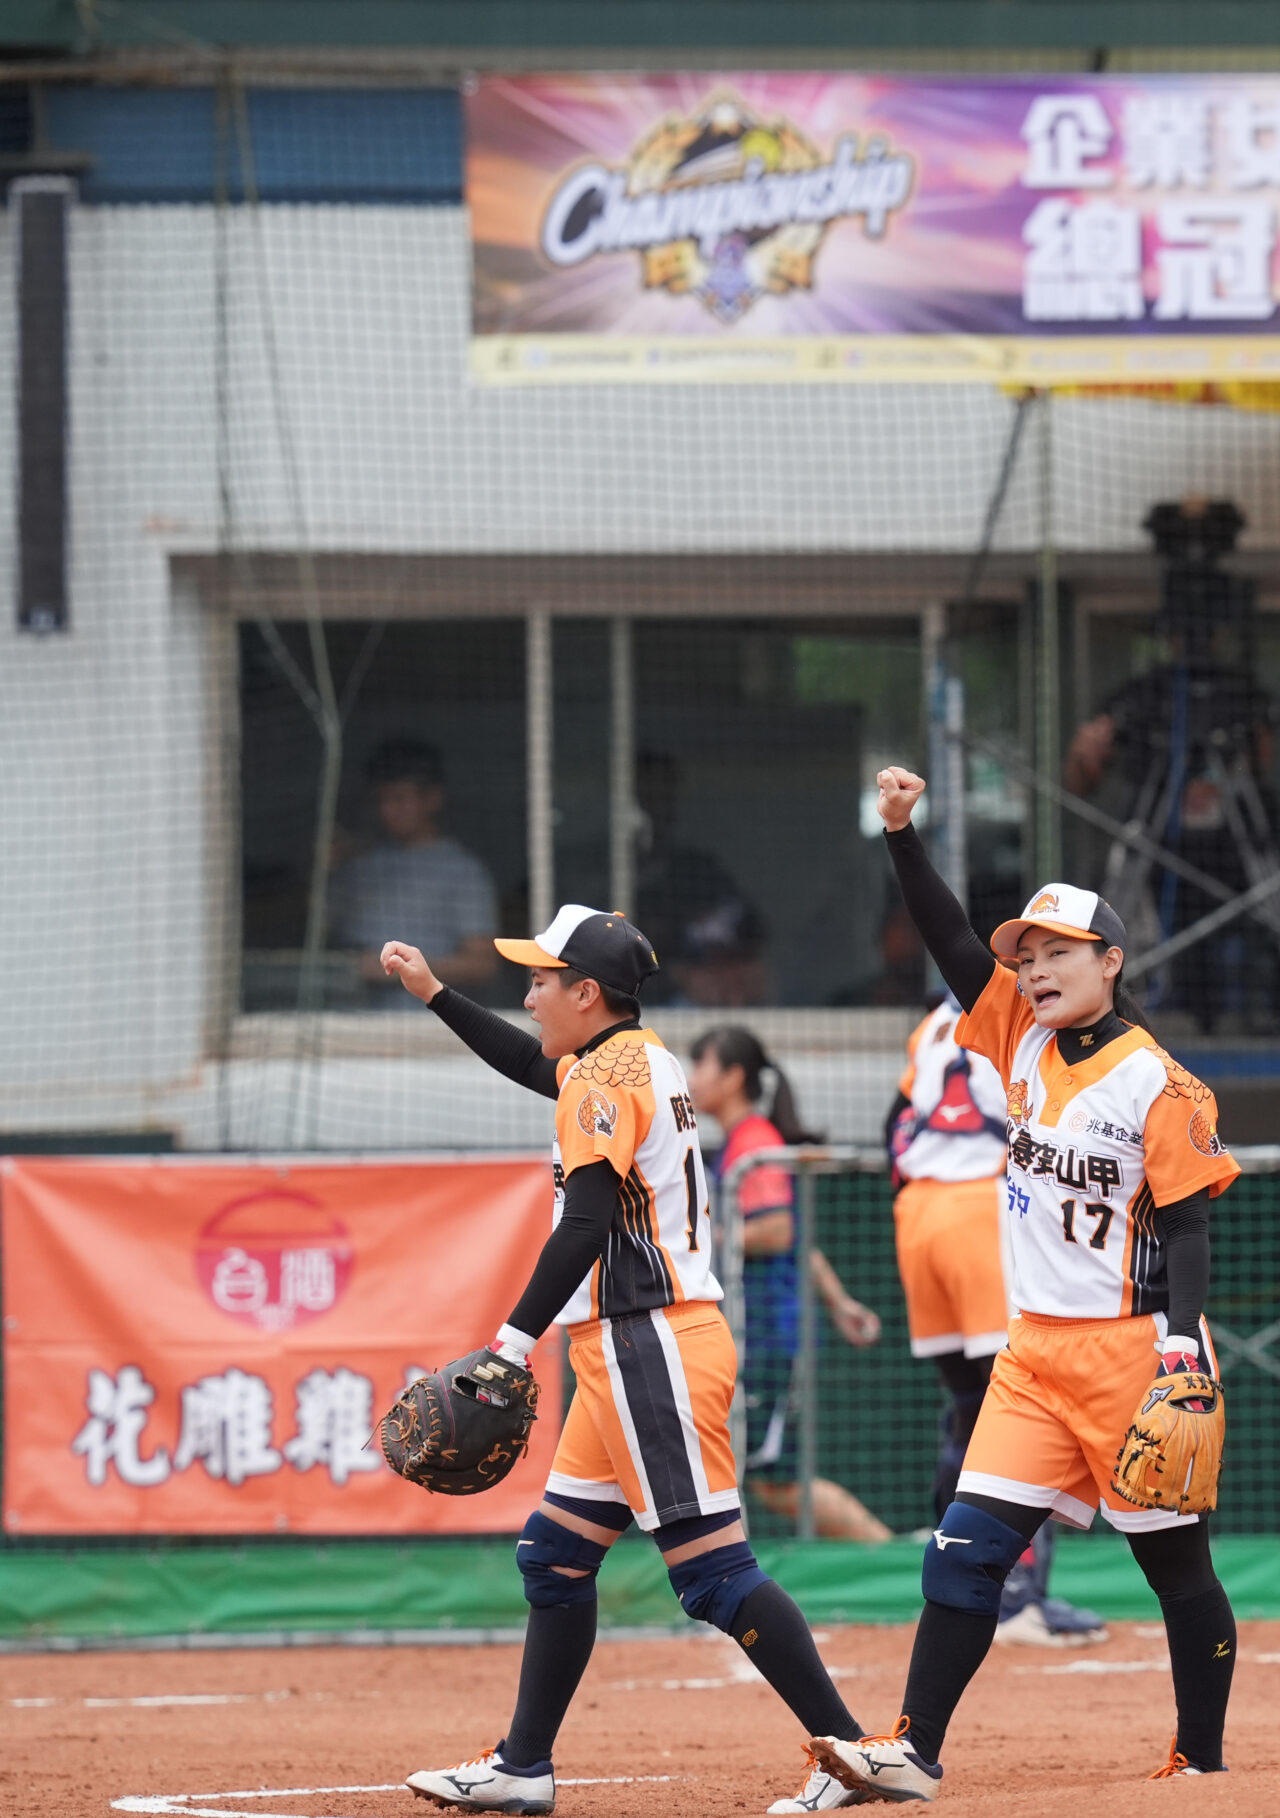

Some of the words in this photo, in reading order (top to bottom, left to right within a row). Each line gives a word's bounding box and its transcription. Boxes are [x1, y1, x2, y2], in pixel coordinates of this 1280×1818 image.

[543, 135, 913, 267] Championship
[1060, 1198, 1115, 1250] 17
[74, 1364, 436, 1487] 花雕雞
